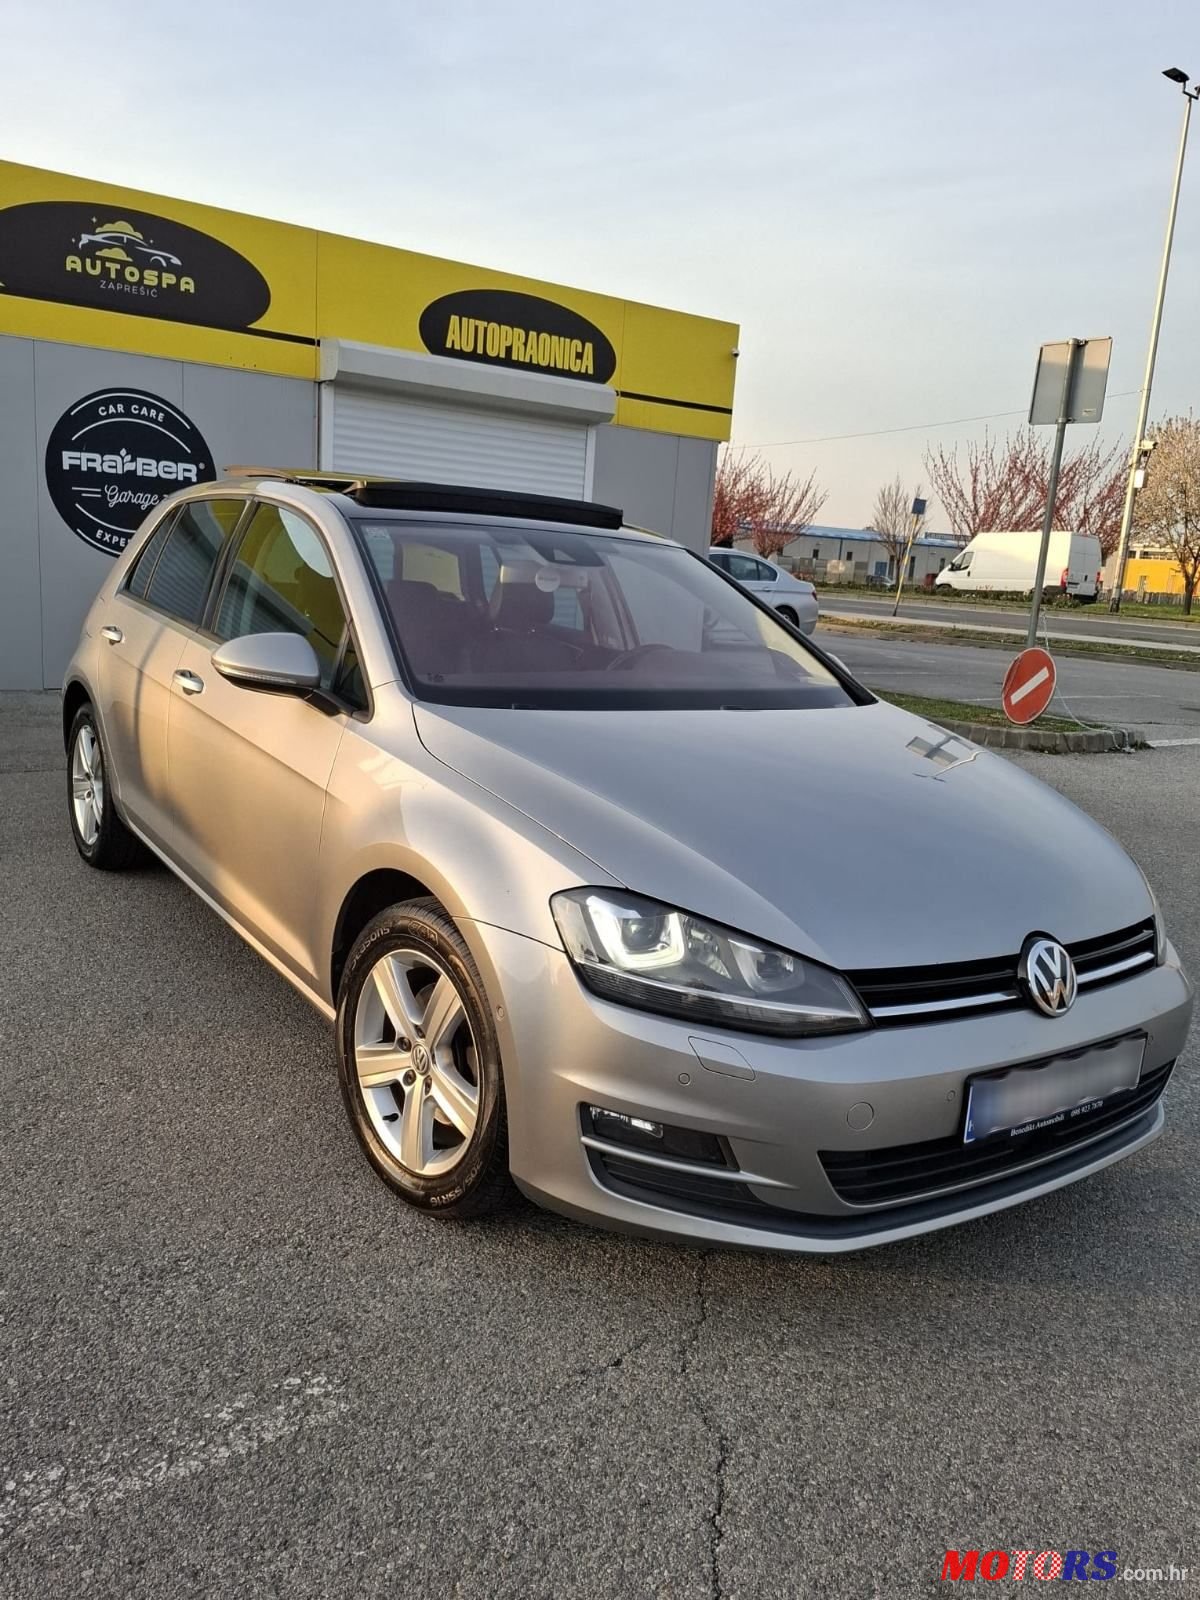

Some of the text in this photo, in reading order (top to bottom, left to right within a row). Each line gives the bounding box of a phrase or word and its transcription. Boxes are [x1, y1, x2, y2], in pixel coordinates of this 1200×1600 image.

[65, 255, 196, 294] AUTOSPA
[99, 278, 159, 299] ZAPREŠIĆ
[445, 314, 594, 375] AUTOPRAONICA
[98, 403, 166, 423] CAR CARE
[104, 484, 161, 511] Garage
